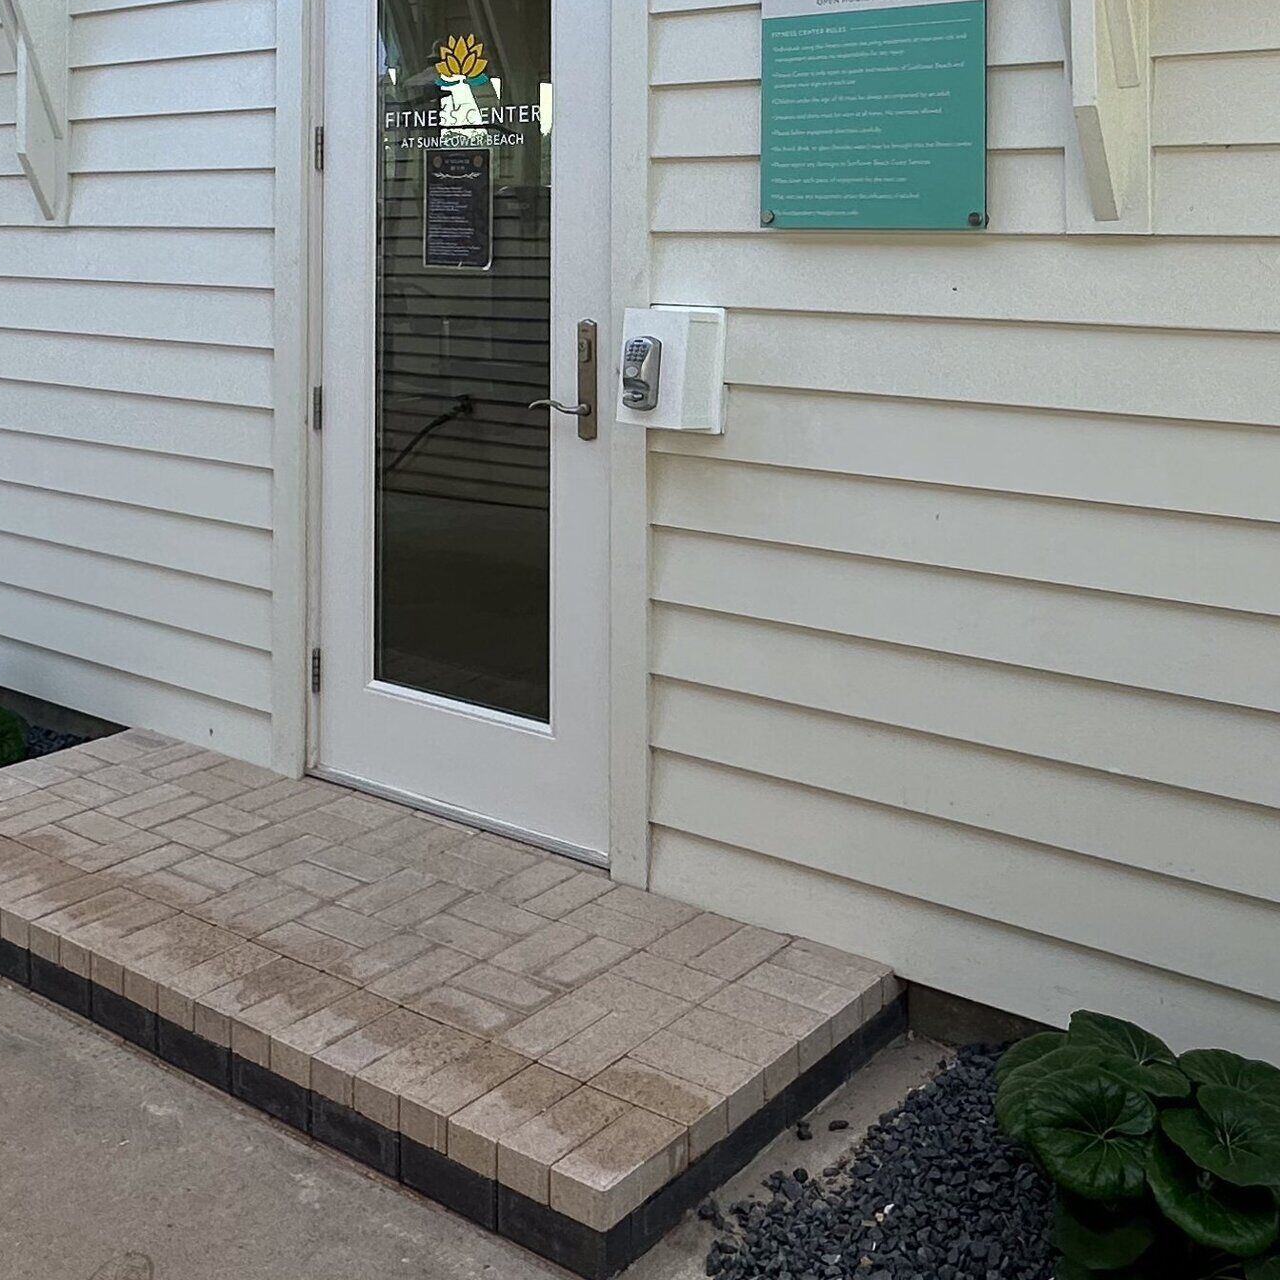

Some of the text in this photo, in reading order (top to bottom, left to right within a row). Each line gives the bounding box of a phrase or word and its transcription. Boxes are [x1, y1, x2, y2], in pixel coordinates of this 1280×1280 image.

[385, 105, 540, 128] FITNESS CENTER
[401, 133, 524, 149] AT SUNFLOWER BEACH
